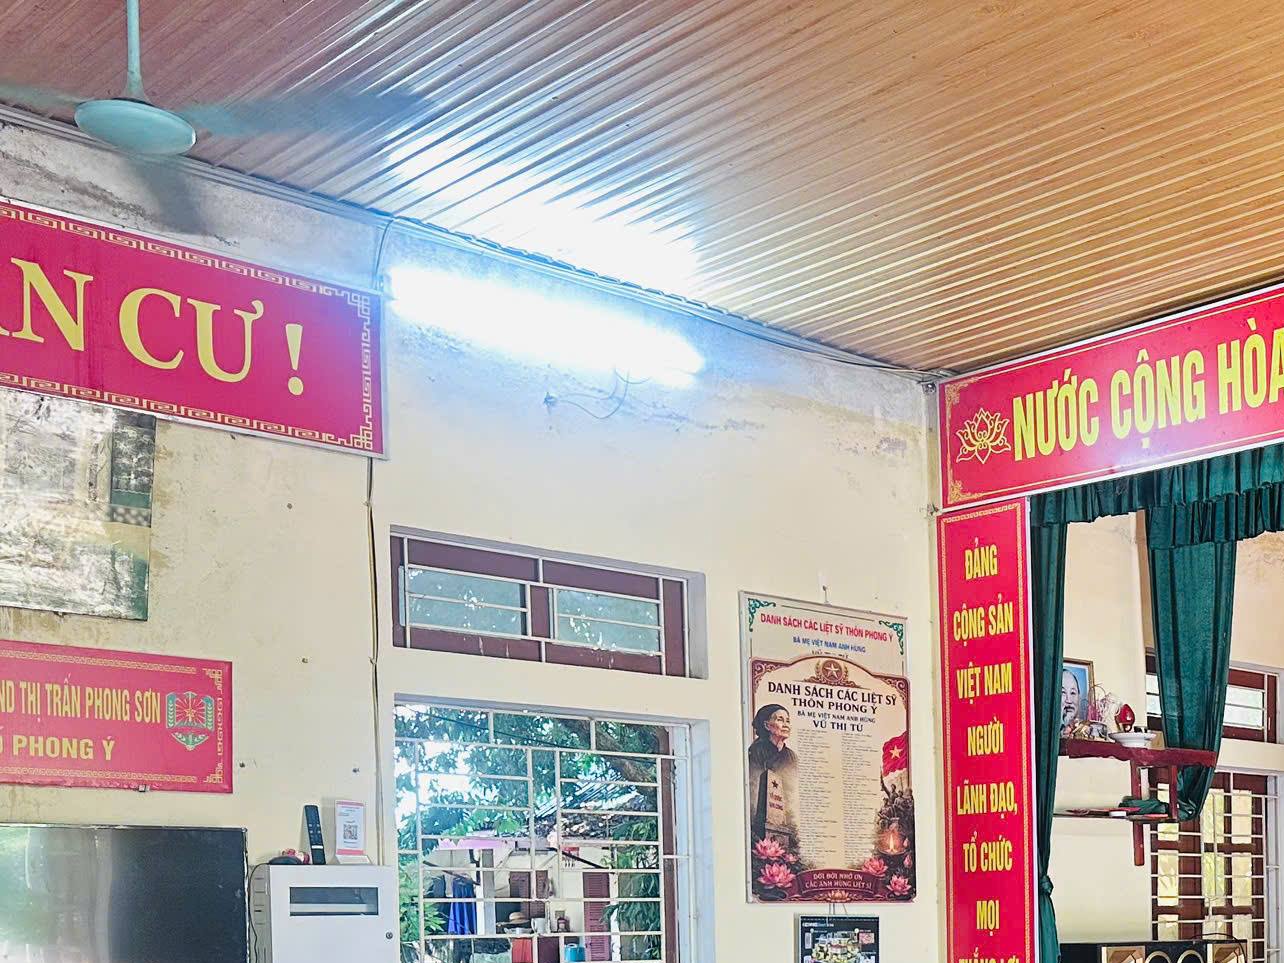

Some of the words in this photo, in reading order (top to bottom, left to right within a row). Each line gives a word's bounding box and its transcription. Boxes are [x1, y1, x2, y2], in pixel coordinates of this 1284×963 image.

[119, 288, 264, 382] CƯ
[1012, 369, 1100, 461] NƯỚC
[1111, 350, 1206, 448] CỘNG
[965, 537, 998, 580] ĐẢNG
[760, 613, 782, 625] DANH
[783, 616, 802, 628] SÁCH
[804, 619, 818, 631] CÁC
[845, 625, 864, 638] THÔN
[864, 630, 887, 642] PHONG
[953, 604, 985, 646] CỘNG
[988, 593, 1014, 636] SẢN
[20, 681, 41, 723] THỊ
[45, 673, 81, 718] TRẤN
[86, 687, 130, 722] PHONG
[134, 688, 161, 724] SƠN
[768, 682, 800, 695] DANH
[804, 684, 833, 699] SÁCH
[837, 687, 858, 701] CÁC
[862, 691, 883, 704] LIỆT
[957, 661, 981, 704] VIỆT
[984, 662, 1013, 696] NAM
[792, 695, 825, 710] THÔN
[828, 700, 868, 714] PHONG
[12, 734, 94, 760] PHONG
[102, 735, 116, 761] Ý
[967, 716, 1004, 757] NGƯỜI
[957, 780, 987, 816] LÃNH
[990, 782, 1018, 819] ĐẠO,
[963, 830, 977, 872] TỔ
[980, 838, 1013, 872] CHỨC
[976, 899, 1000, 936] MỌI
